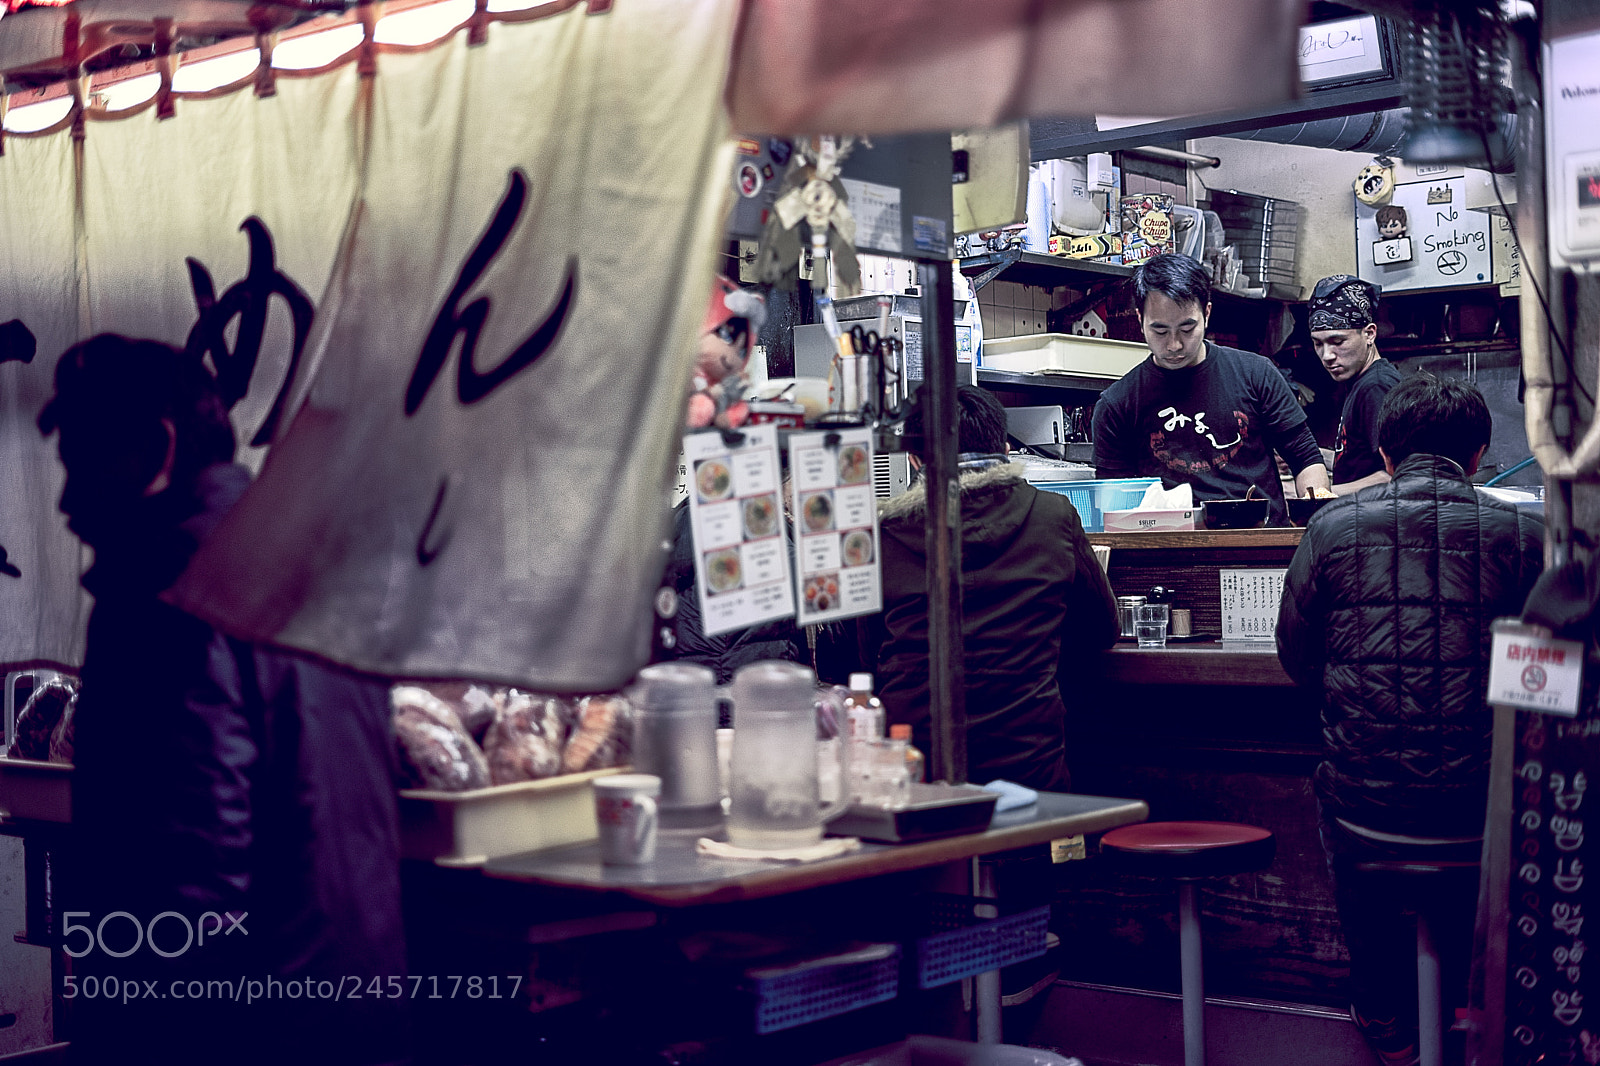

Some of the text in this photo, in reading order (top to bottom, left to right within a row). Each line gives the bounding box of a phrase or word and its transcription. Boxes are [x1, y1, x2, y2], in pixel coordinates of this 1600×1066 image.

[1144, 218, 1168, 228] Chupa
[1436, 206, 1459, 227] No
[1143, 226, 1168, 238] Chups
[1423, 229, 1486, 253] Smoking
[1158, 407, 1242, 450] みよし
